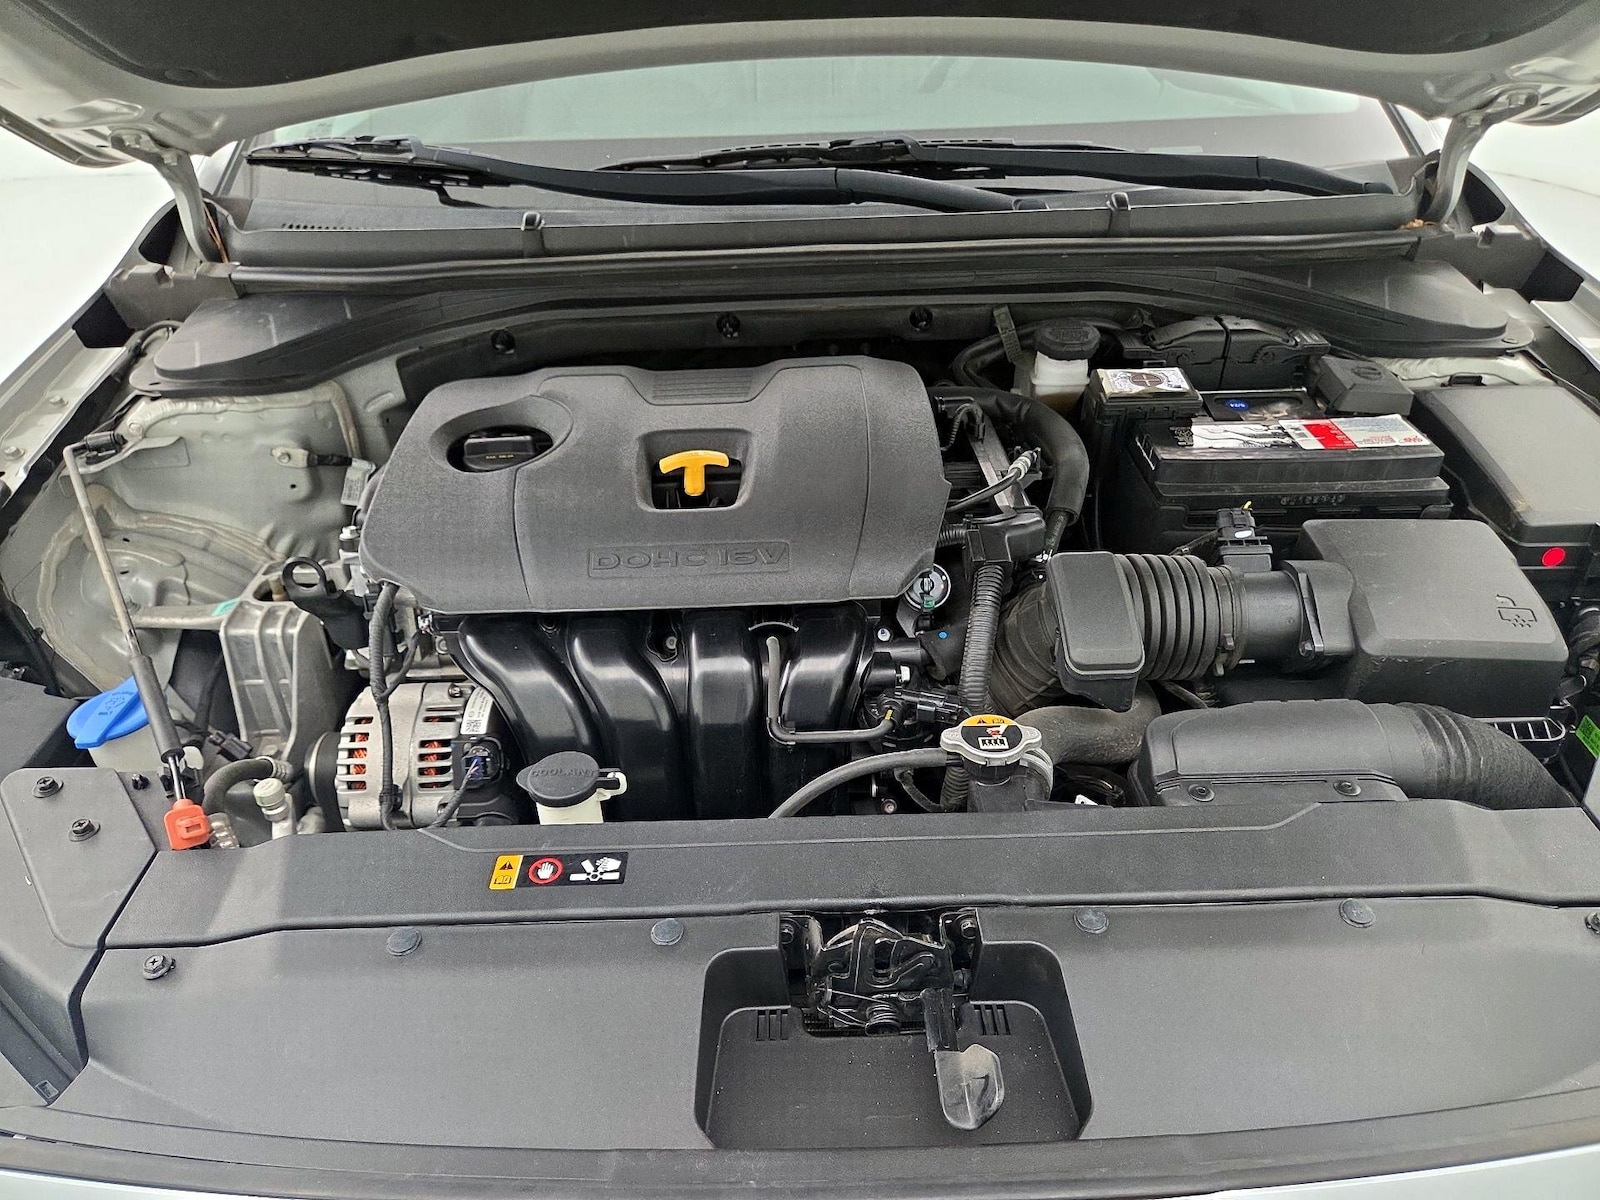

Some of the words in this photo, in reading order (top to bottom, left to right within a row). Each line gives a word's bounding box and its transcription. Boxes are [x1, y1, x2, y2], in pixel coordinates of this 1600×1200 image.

[592, 549, 708, 570] DOHC
[717, 545, 787, 566] 16V
[531, 767, 598, 777] COOLANT
